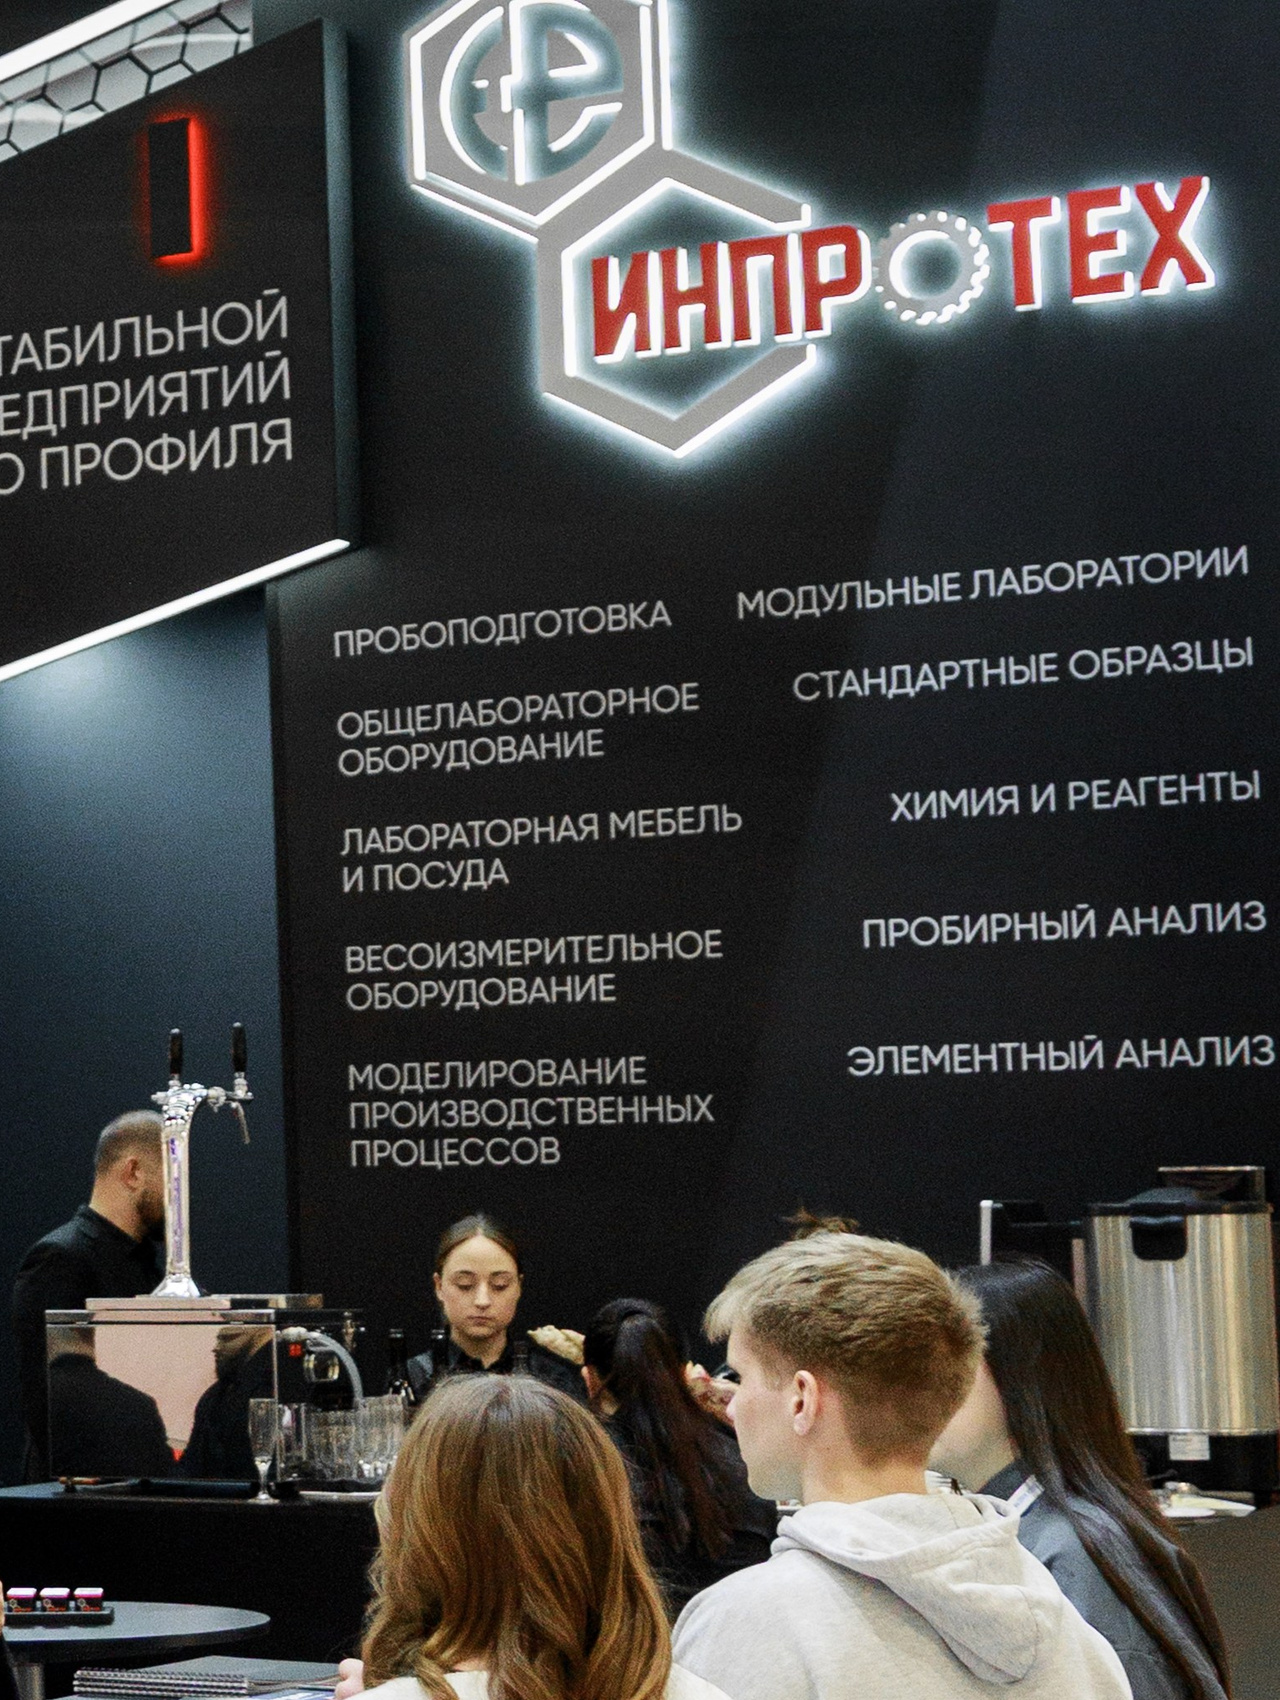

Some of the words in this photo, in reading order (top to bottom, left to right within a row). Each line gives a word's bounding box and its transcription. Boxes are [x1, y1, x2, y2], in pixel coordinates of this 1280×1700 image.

[590, 175, 1216, 364] ИНПРОТЕХ
[40, 417, 293, 490] ПРОФИЛЯ
[737, 571, 962, 620] МОДУЛЬНЫЕ
[969, 545, 1249, 600] ЛАБОРАТОРИИ
[333, 600, 672, 658] ПРОБОПОДГОТОВКА
[793, 652, 1060, 701] СТАНДАРТНЫЕ
[1068, 636, 1254, 680] ОБРАЗЦЫ
[336, 682, 699, 740] ОБЩЕЛАБОРАТОРНОЕ
[338, 728, 604, 777] ОБОРУДОВАНИЕ
[890, 784, 1020, 822] ХИМИЯ
[1031, 782, 1056, 814] И
[1067, 769, 1260, 811] РЕАГЕНТЫ
[340, 813, 599, 856] ЛАБОРАТОРНАЯ
[609, 804, 743, 839] МЕБЕЛЬ
[342, 865, 364, 893] И
[373, 857, 510, 891] ПОСУДА
[862, 903, 1097, 949] ПРОБИРНЫЙ
[1106, 900, 1267, 938] АНАЛИЗ
[345, 929, 723, 973] ВЕСОИЗМЕРИТЕЛЬНОЕ
[346, 973, 617, 1011] ОБОРУДОВАНИЕ
[348, 1056, 647, 1094] МОДЕЛИРОВАНИЕ
[847, 1034, 1104, 1077] ЭЛЕМЕНТНЫЙ
[1115, 1034, 1275, 1069] АНАЛИЗ
[350, 1094, 714, 1130] ПРОИЗВОДСТВЕННЫХ
[351, 1136, 561, 1170] ПРОЦЕССОВ
